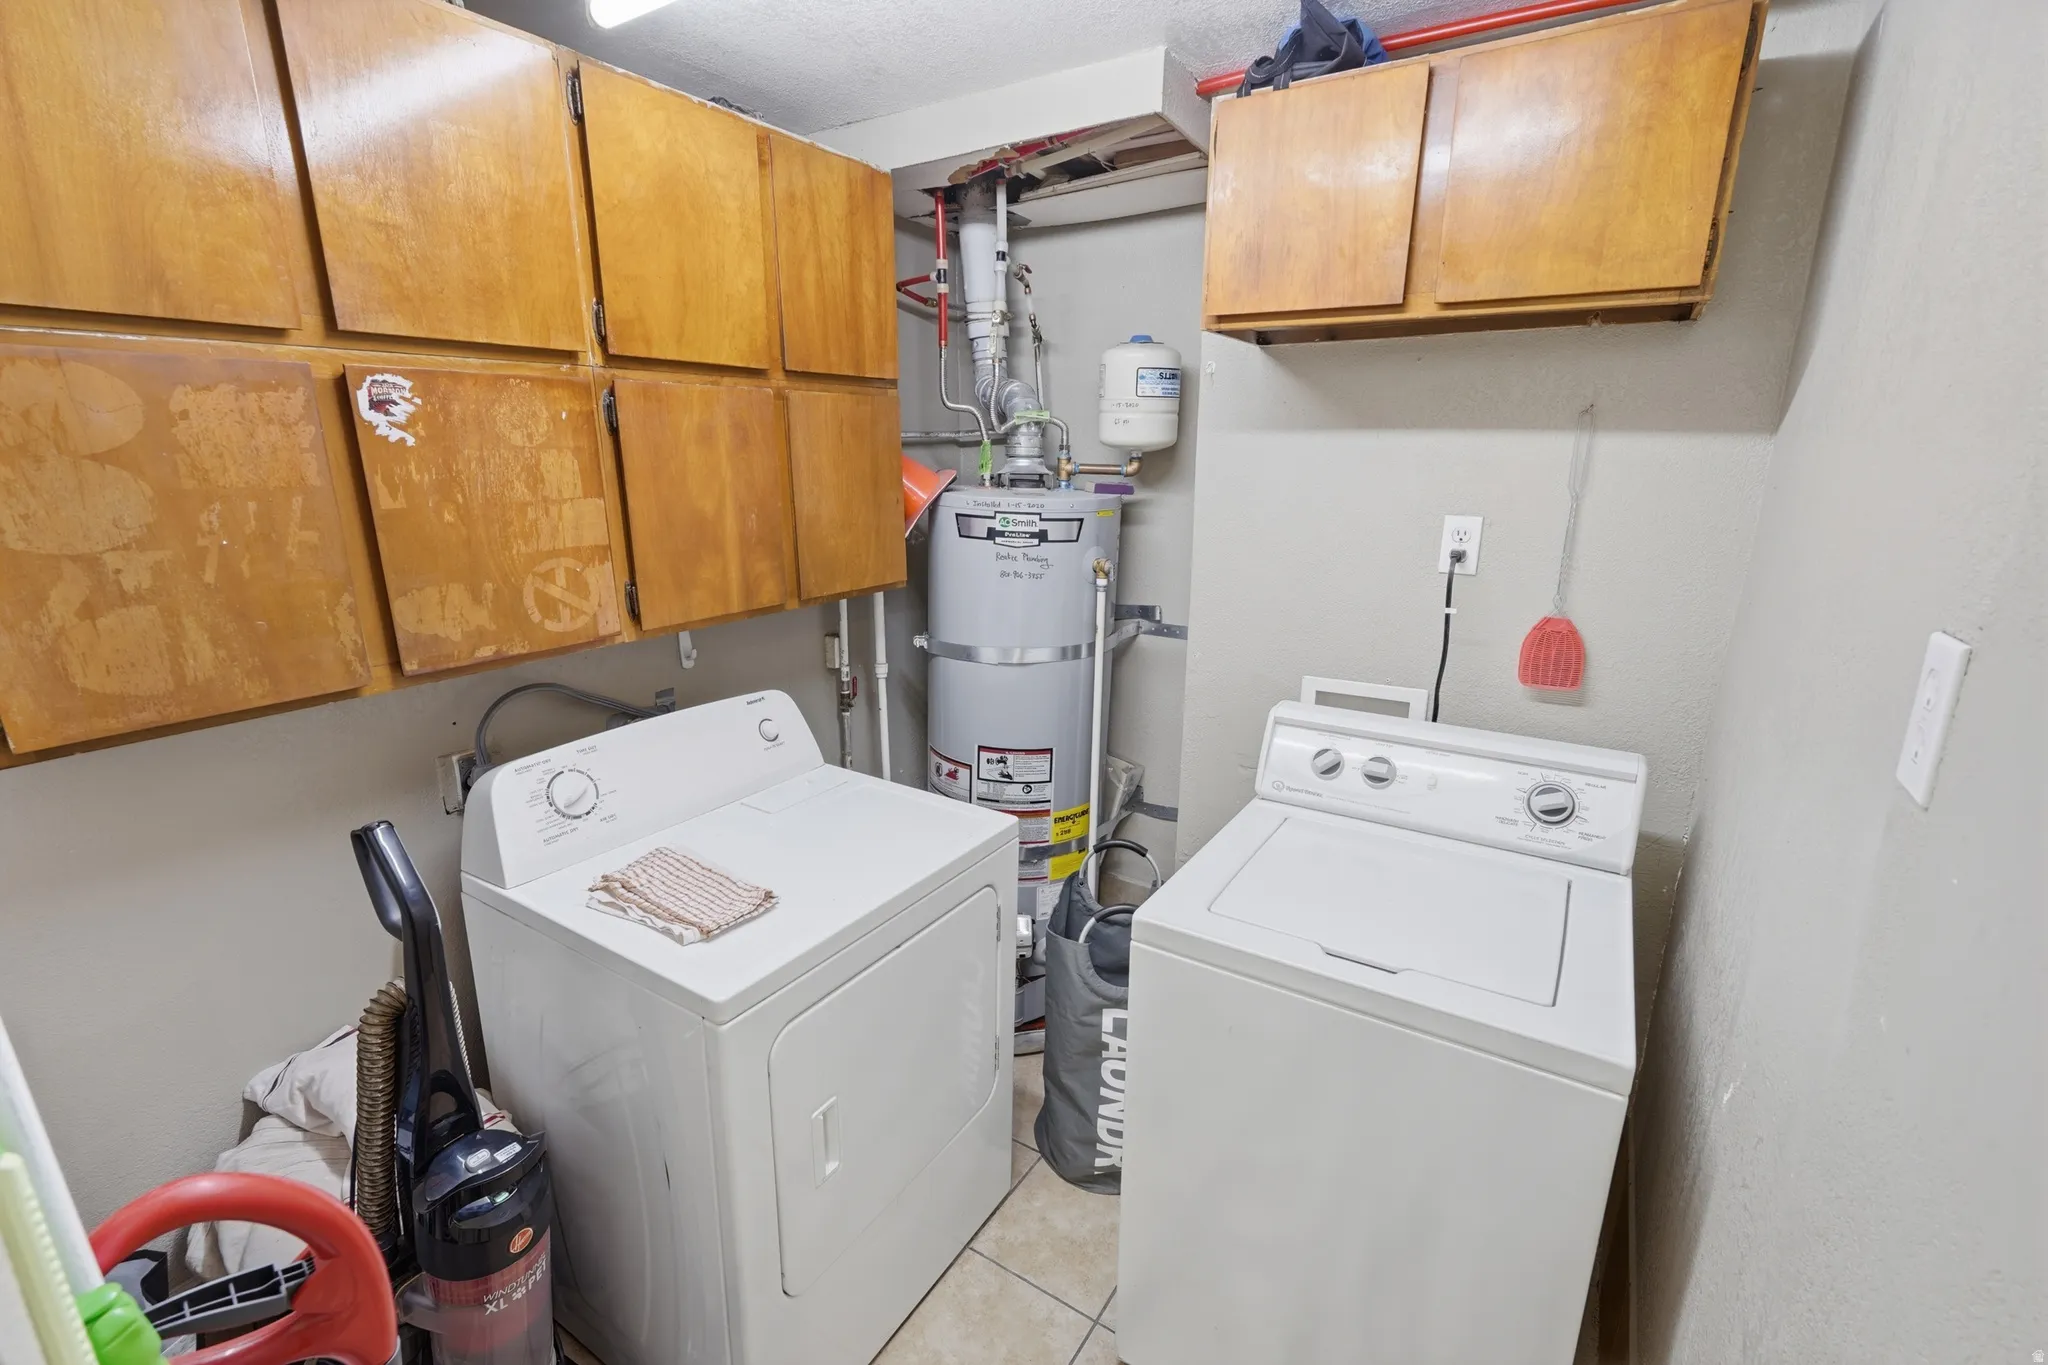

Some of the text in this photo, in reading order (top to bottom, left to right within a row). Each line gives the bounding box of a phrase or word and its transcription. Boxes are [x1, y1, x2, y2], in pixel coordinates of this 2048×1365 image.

[1094, 1008, 1129, 1175] LAUNDR
[484, 1257, 547, 1316] XL PET
